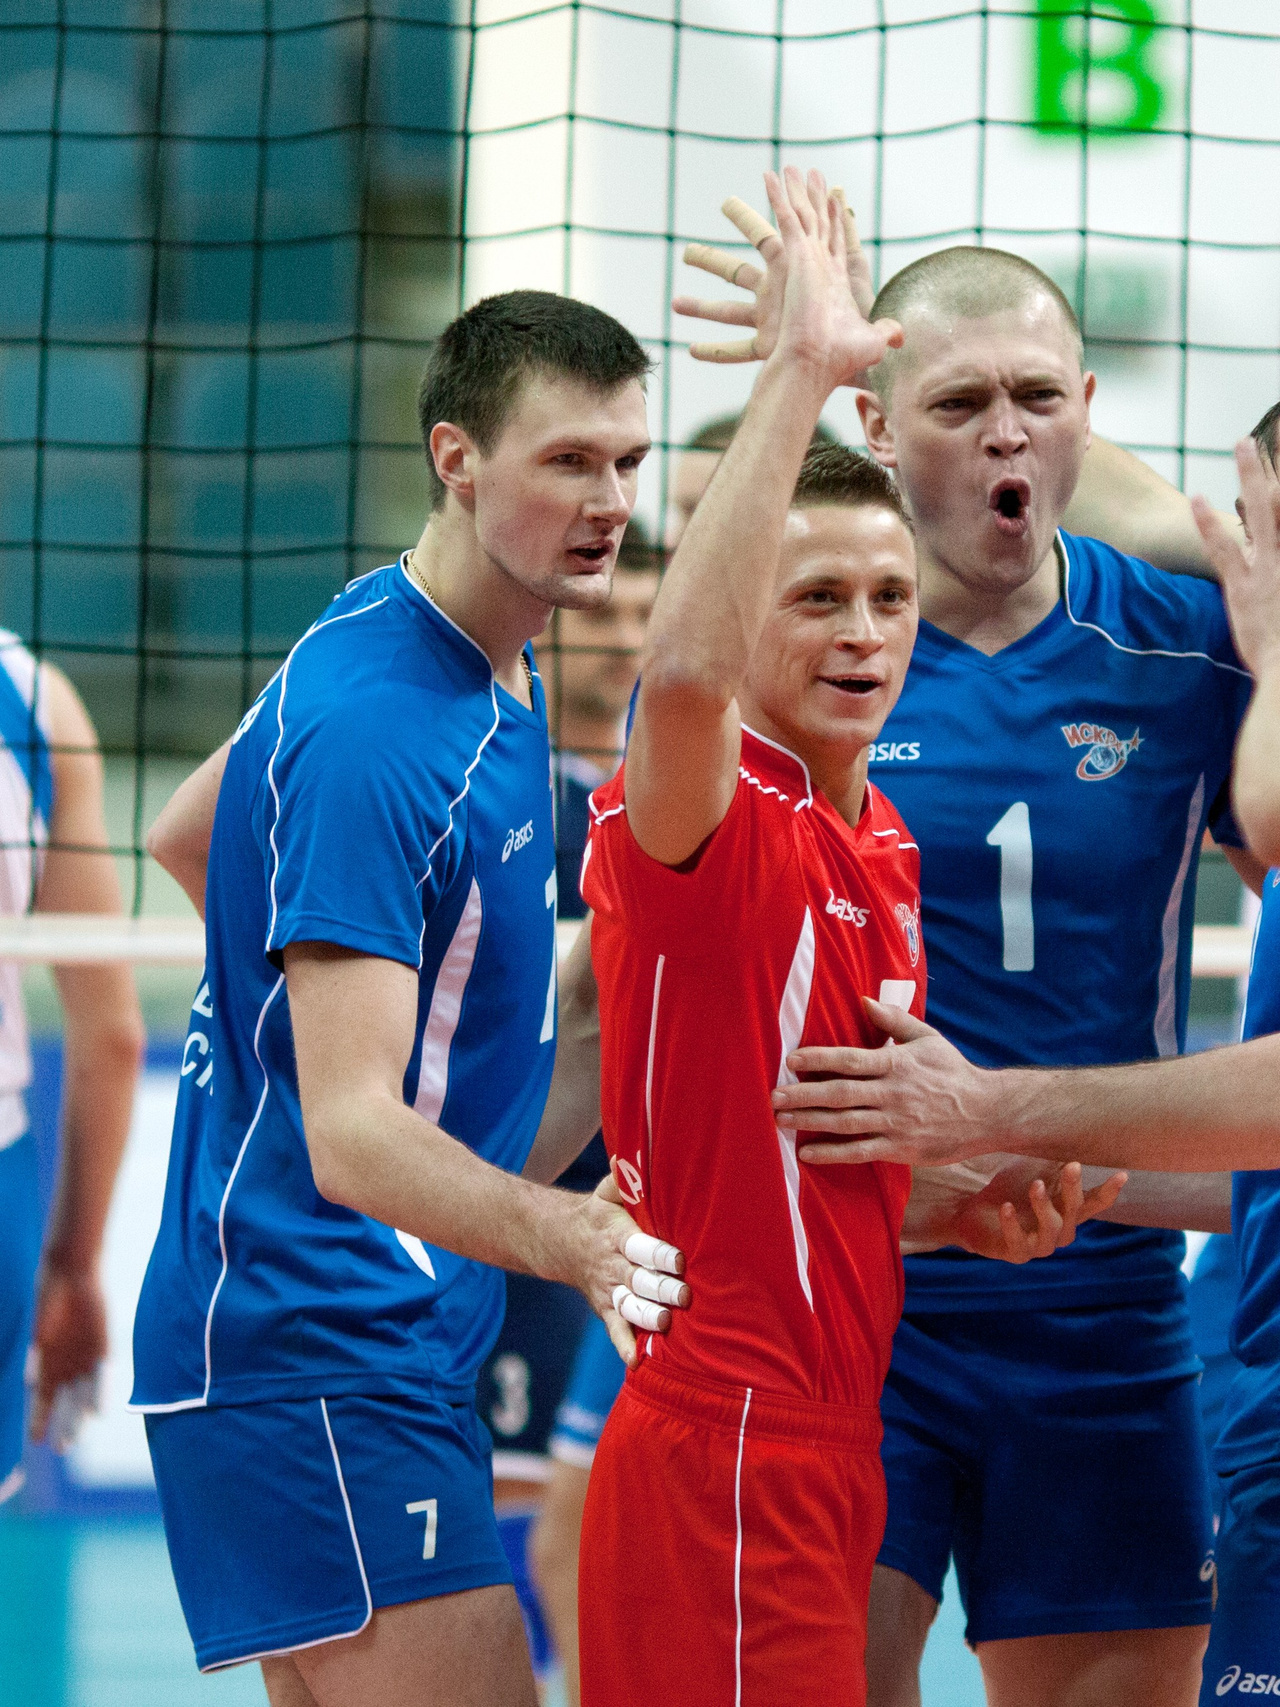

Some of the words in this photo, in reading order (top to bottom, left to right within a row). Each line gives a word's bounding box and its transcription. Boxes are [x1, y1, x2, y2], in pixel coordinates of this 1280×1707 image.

[986, 801, 1035, 972] 1
[492, 1352, 532, 1438] 3
[405, 1498, 438, 1560] 7
